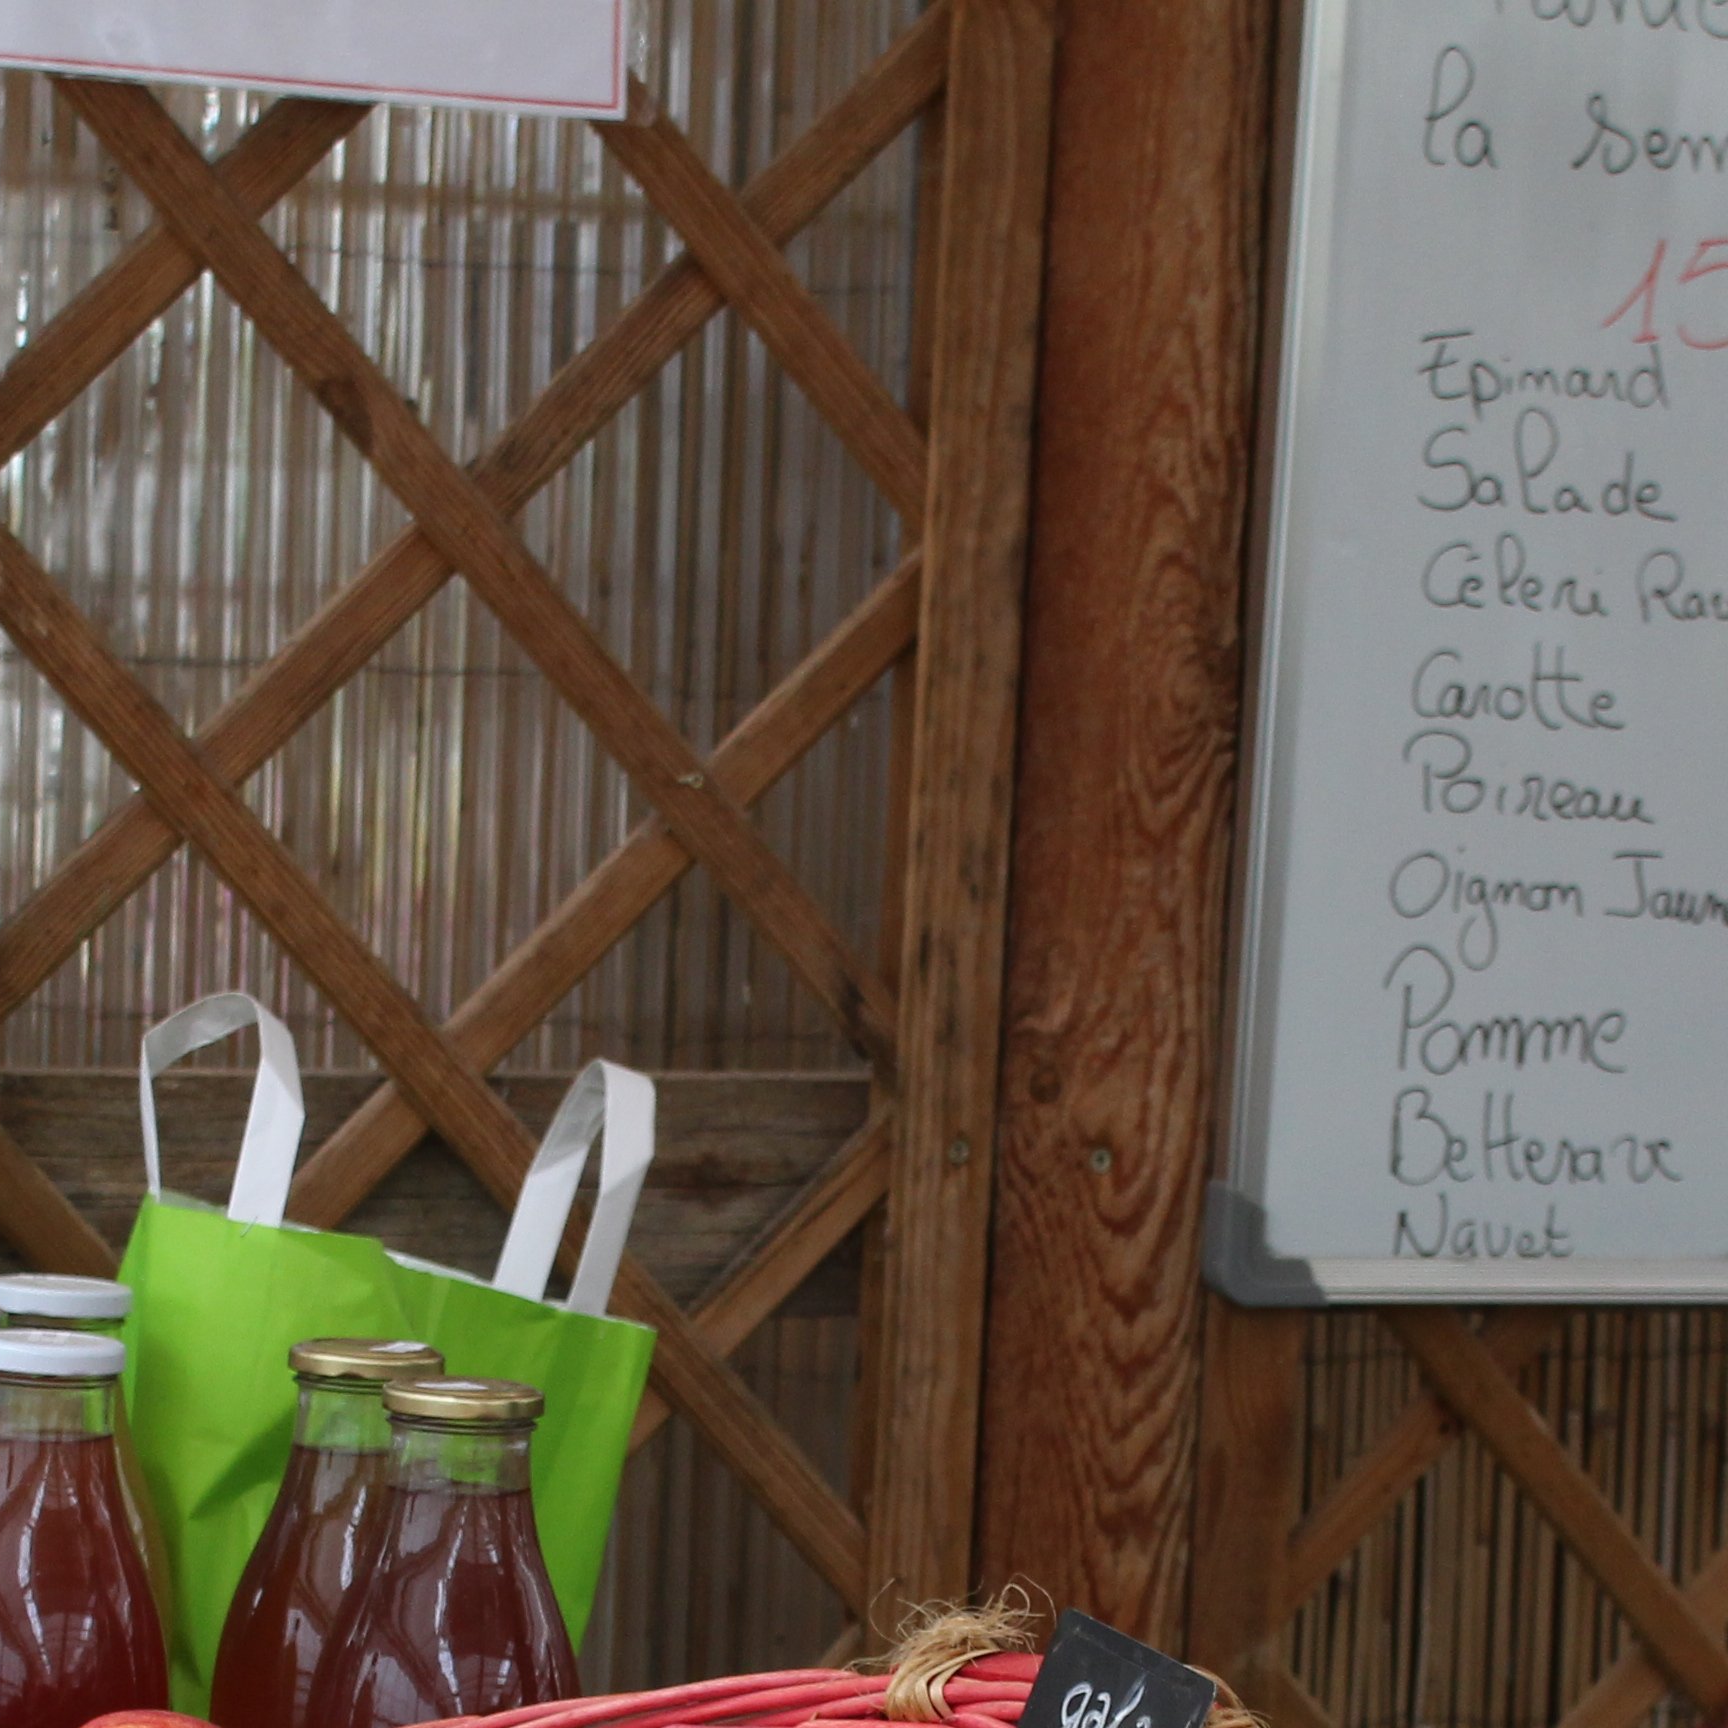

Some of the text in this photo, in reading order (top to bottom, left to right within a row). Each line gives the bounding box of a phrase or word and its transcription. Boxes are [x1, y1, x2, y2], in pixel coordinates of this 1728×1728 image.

[1424, 44, 1499, 168] la
[1417, 407, 1678, 522] Salade
[1421, 531, 1610, 617] Céleri
[1411, 640, 1626, 730] Carotte
[1403, 730, 1654, 825] Poireau
[1388, 846, 1584, 972] Oignon
[1383, 943, 1628, 1075] Pomme
[1387, 1086, 1684, 1187] Betterave
[1392, 1193, 1574, 1260] Navet
